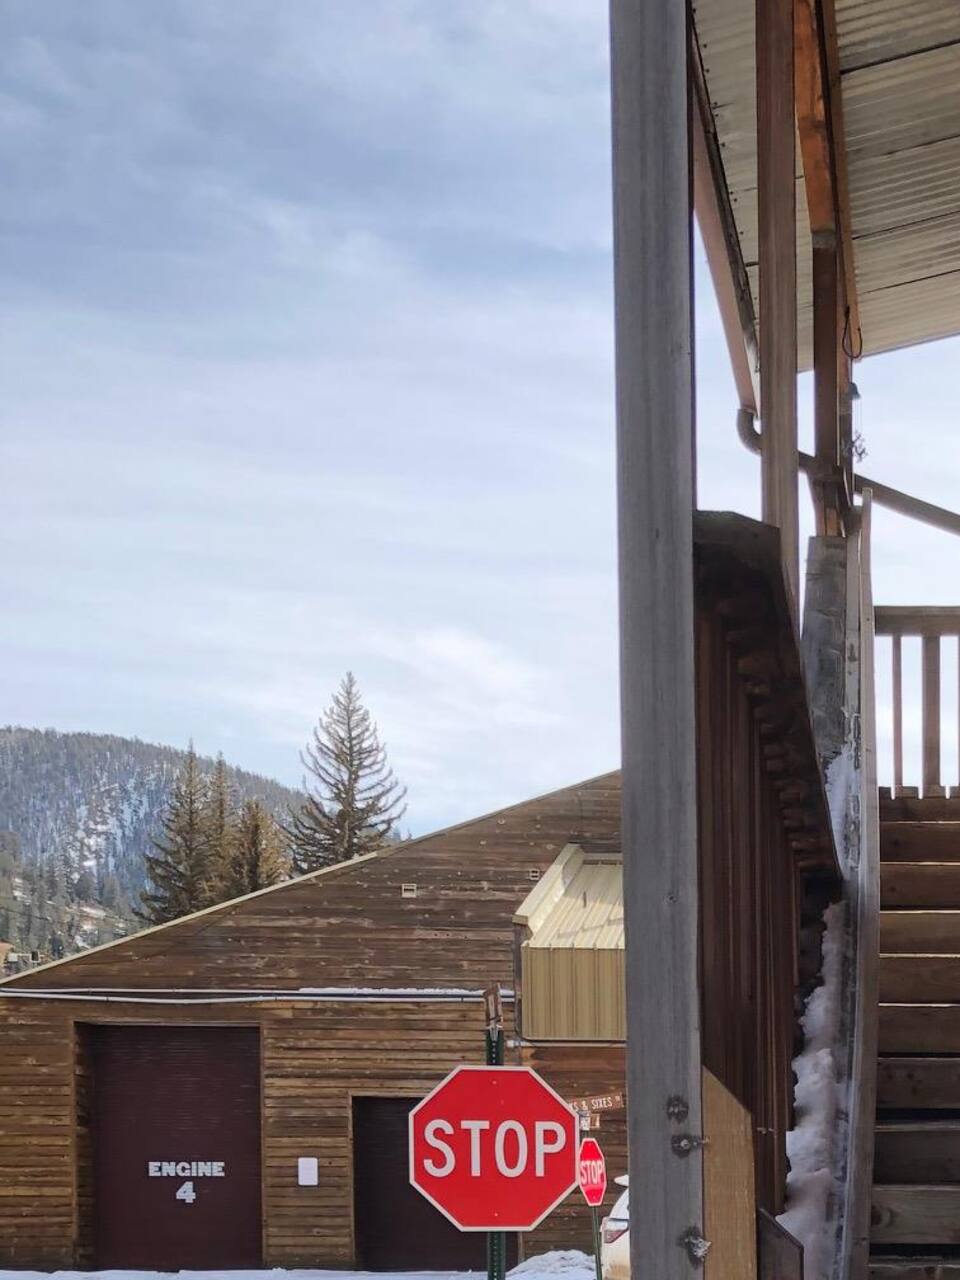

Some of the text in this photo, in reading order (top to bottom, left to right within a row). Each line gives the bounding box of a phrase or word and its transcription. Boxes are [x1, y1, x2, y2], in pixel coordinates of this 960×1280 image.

[423, 1119, 567, 1178] STOP
[148, 1161, 226, 1177] ENGINE
[580, 1160, 603, 1185] STOP
[176, 1181, 196, 1204] 4
